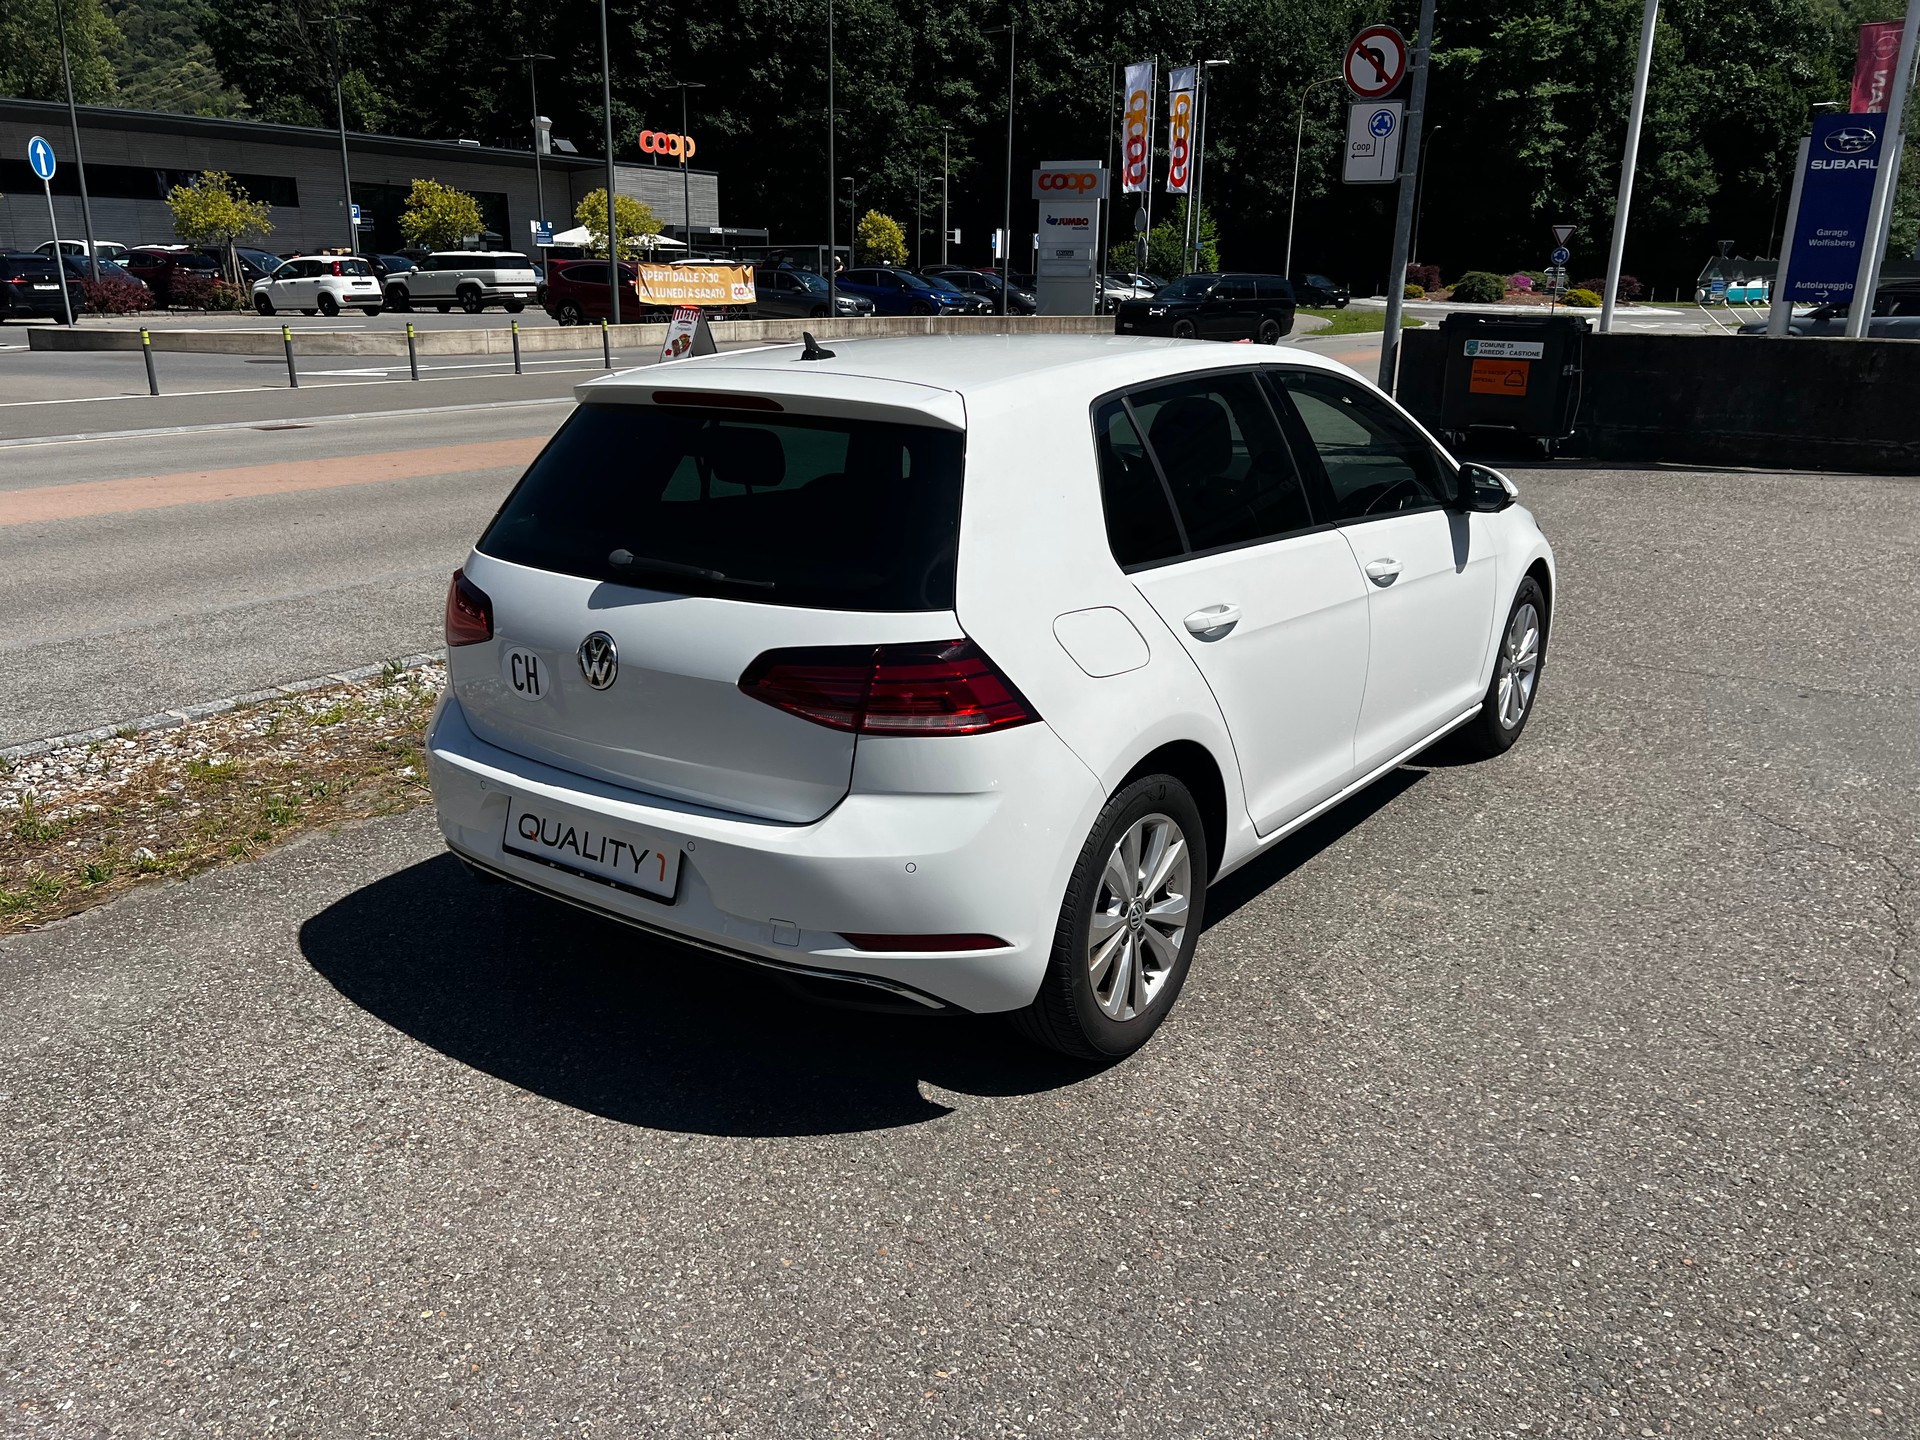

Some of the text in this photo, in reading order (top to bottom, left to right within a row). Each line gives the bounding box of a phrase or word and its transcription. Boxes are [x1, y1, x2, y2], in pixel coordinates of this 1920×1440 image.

[638, 129, 697, 163] coop
[1351, 141, 1371, 153] Coop
[1038, 172, 1098, 195] coop
[1057, 217, 1090, 226] JUMBO
[1816, 228, 1849, 238] Garage
[1808, 239, 1856, 248] Wolfisberg
[673, 271, 700, 283] DALLE
[701, 272, 719, 283] 7:30
[641, 285, 726, 299] DA LUNEDÌ A SABATO
[1794, 281, 1854, 291] Autolavaggio
[511, 652, 541, 696] CH
[518, 813, 666, 882] QUALITY 1
